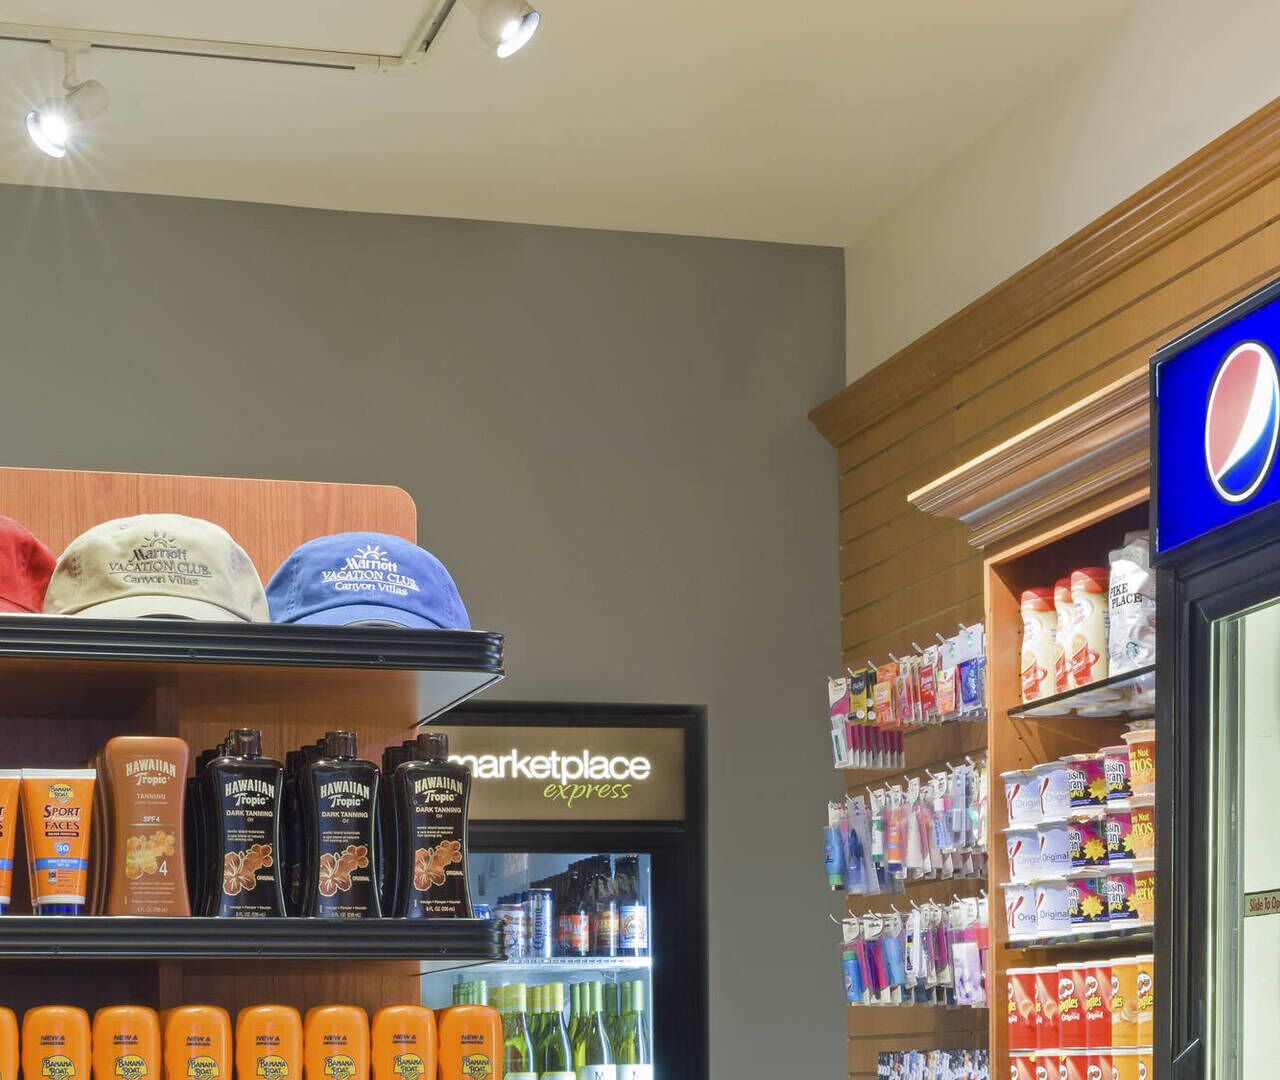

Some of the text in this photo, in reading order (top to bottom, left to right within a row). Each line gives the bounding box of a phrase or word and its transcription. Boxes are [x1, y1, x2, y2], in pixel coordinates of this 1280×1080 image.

[128, 547, 188, 562] Marriott
[109, 559, 212, 577] VACATION CLUB
[341, 556, 398, 573] Marriott
[122, 574, 201, 587] Canyon Villas
[322, 569, 420, 591] VACATION CLUB
[334, 580, 409, 597] Canyon Villas
[1111, 592, 1143, 610] PLACE
[126, 758, 177, 778] HAWAIIAN
[1104, 762, 1125, 776] aisin
[135, 773, 170, 786] Tropic
[414, 776, 463, 795] HAWAIIAN
[1106, 773, 1124, 786] ran
[225, 779, 275, 799] HAWAIIAN
[320, 780, 370, 799] HAWAIIAN
[423, 789, 457, 804] Tropic
[543, 781, 633, 807] express
[234, 792, 268, 807] Tropic
[328, 794, 363, 808] Tropic
[43, 804, 80, 818] SPORT
[243, 810, 273, 818] TANNING
[44, 820, 80, 830] FACES
[158, 860, 168, 877] 4
[1249, 896, 1263, 912] Slide
[1263, 896, 1270, 910] To
